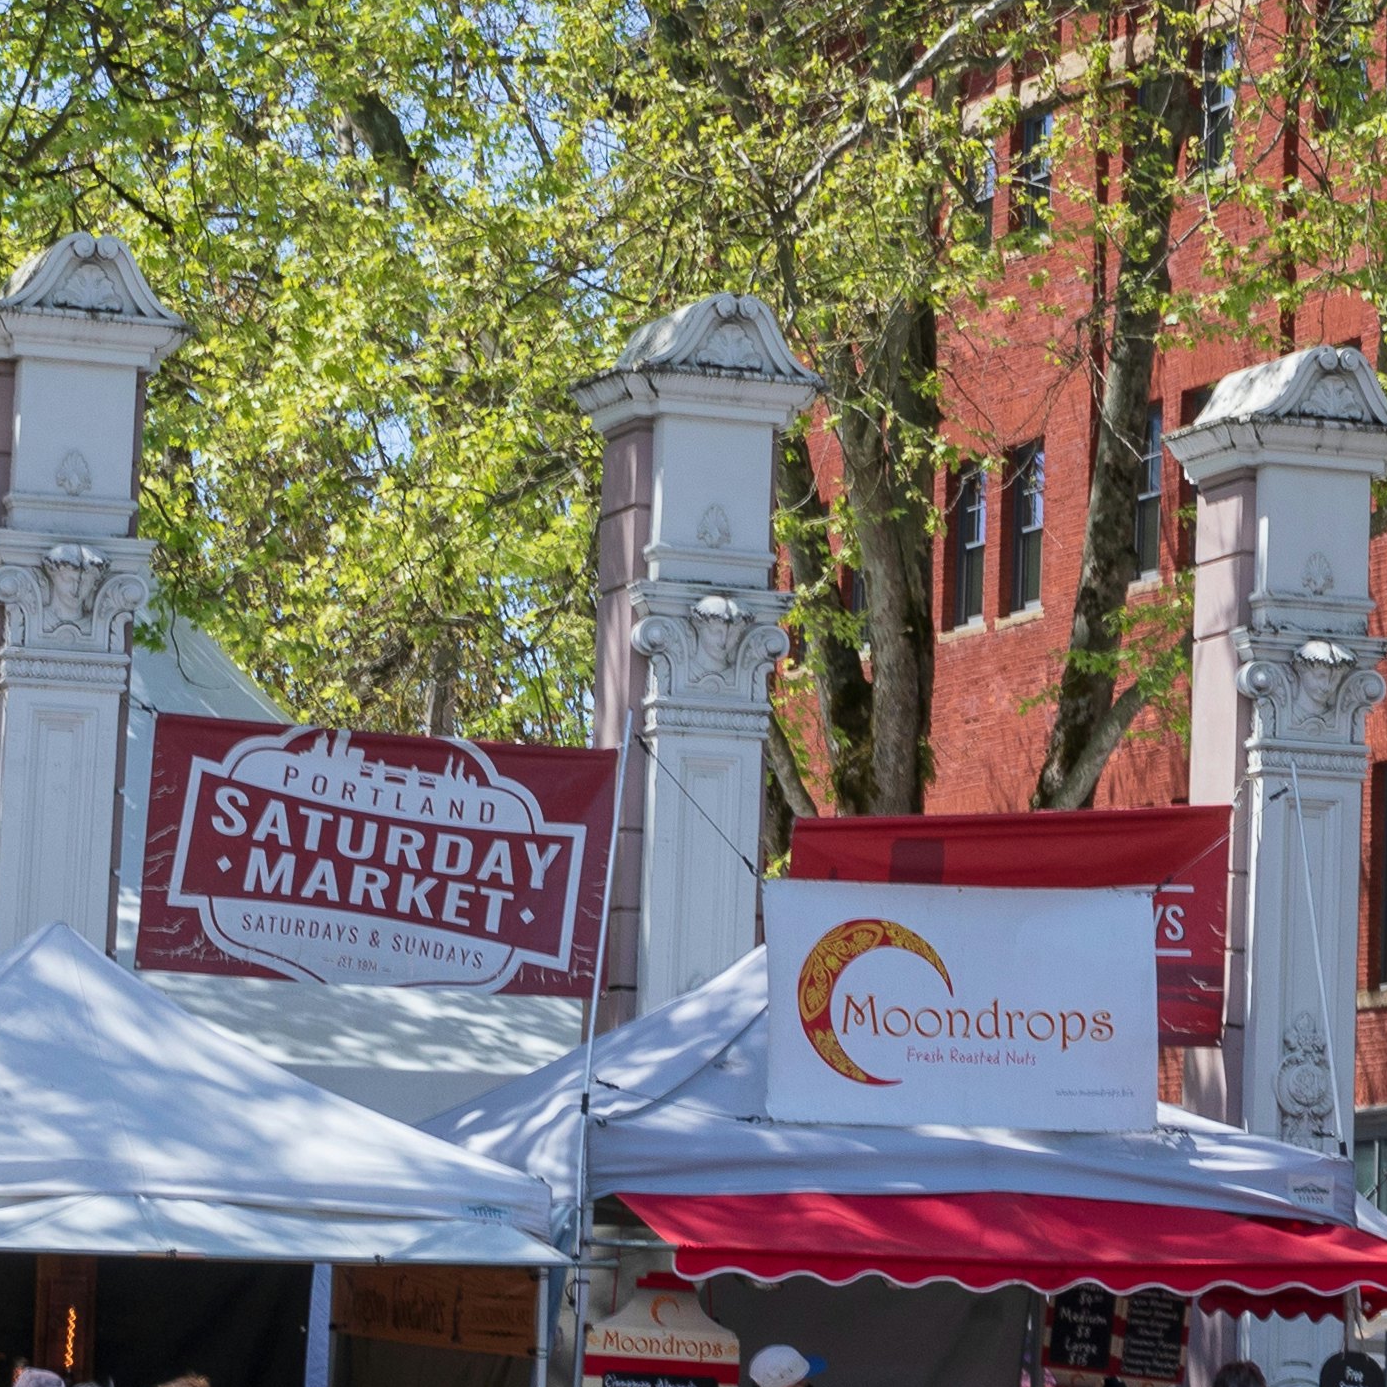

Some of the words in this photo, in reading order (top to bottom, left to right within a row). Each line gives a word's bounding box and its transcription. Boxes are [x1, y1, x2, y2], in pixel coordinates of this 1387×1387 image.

[283, 765, 496, 824] PORTLAND
[211, 786, 561, 891] SATURDAY
[242, 847, 515, 934] MARKET
[241, 913, 358, 947] SATURDAYS
[368, 929, 380, 949] &
[392, 935, 484, 971] SUNDAYS
[842, 994, 1114, 1052] Moondrops
[906, 1045, 944, 1063] Fresh
[950, 1046, 1000, 1066] Roasted
[1006, 1049, 1036, 1066] Nuts
[1060, 1306, 1107, 1325] Medium
[603, 1329, 723, 1362] Moondrops
[1065, 1336, 1098, 1355] Large
[1346, 1366, 1363, 1383] Free
